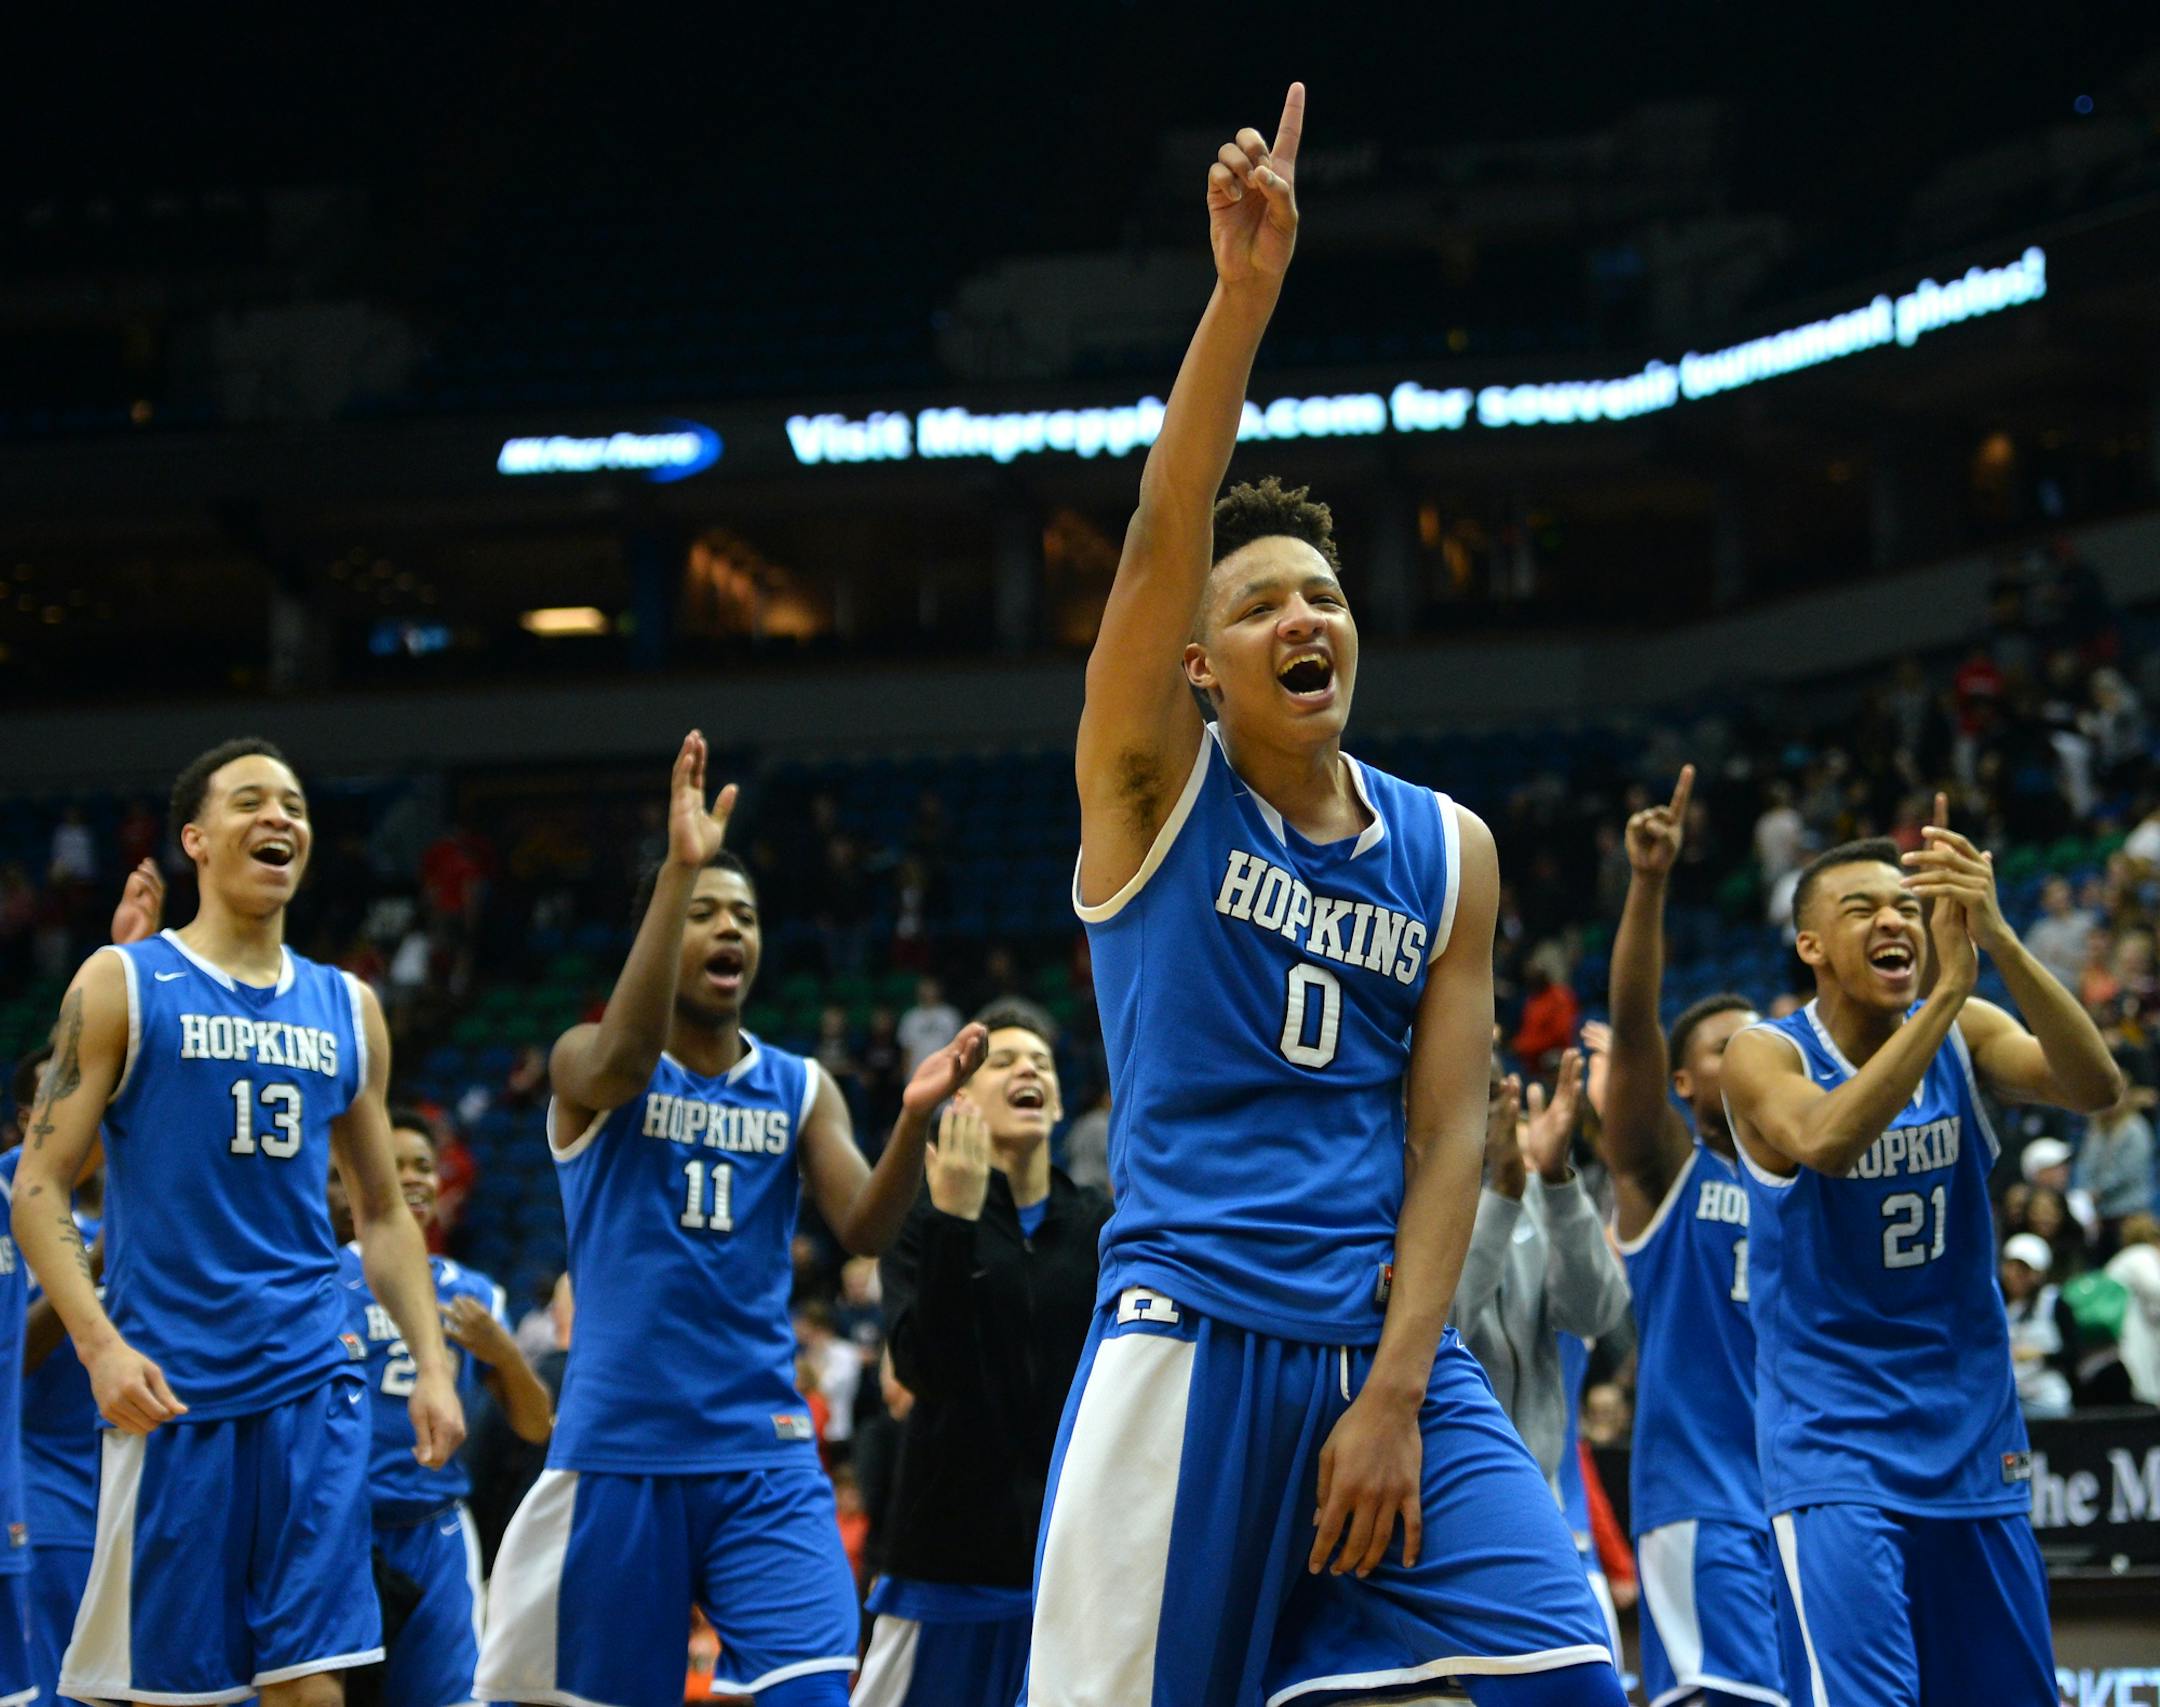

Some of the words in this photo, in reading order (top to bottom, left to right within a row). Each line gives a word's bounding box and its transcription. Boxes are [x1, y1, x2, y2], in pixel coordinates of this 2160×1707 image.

[1214, 849, 1428, 986] HOPKINS
[179, 1013, 339, 1077] HOPKINS
[1279, 962, 1342, 1069] 0
[229, 1079, 302, 1159] 13
[642, 1092, 790, 1155] HOPKINS
[1847, 1115, 1961, 1179] OPKIN
[680, 1160, 734, 1232] 11
[1881, 1185, 1946, 1269] 21
[2030, 1450, 2099, 1528] he
